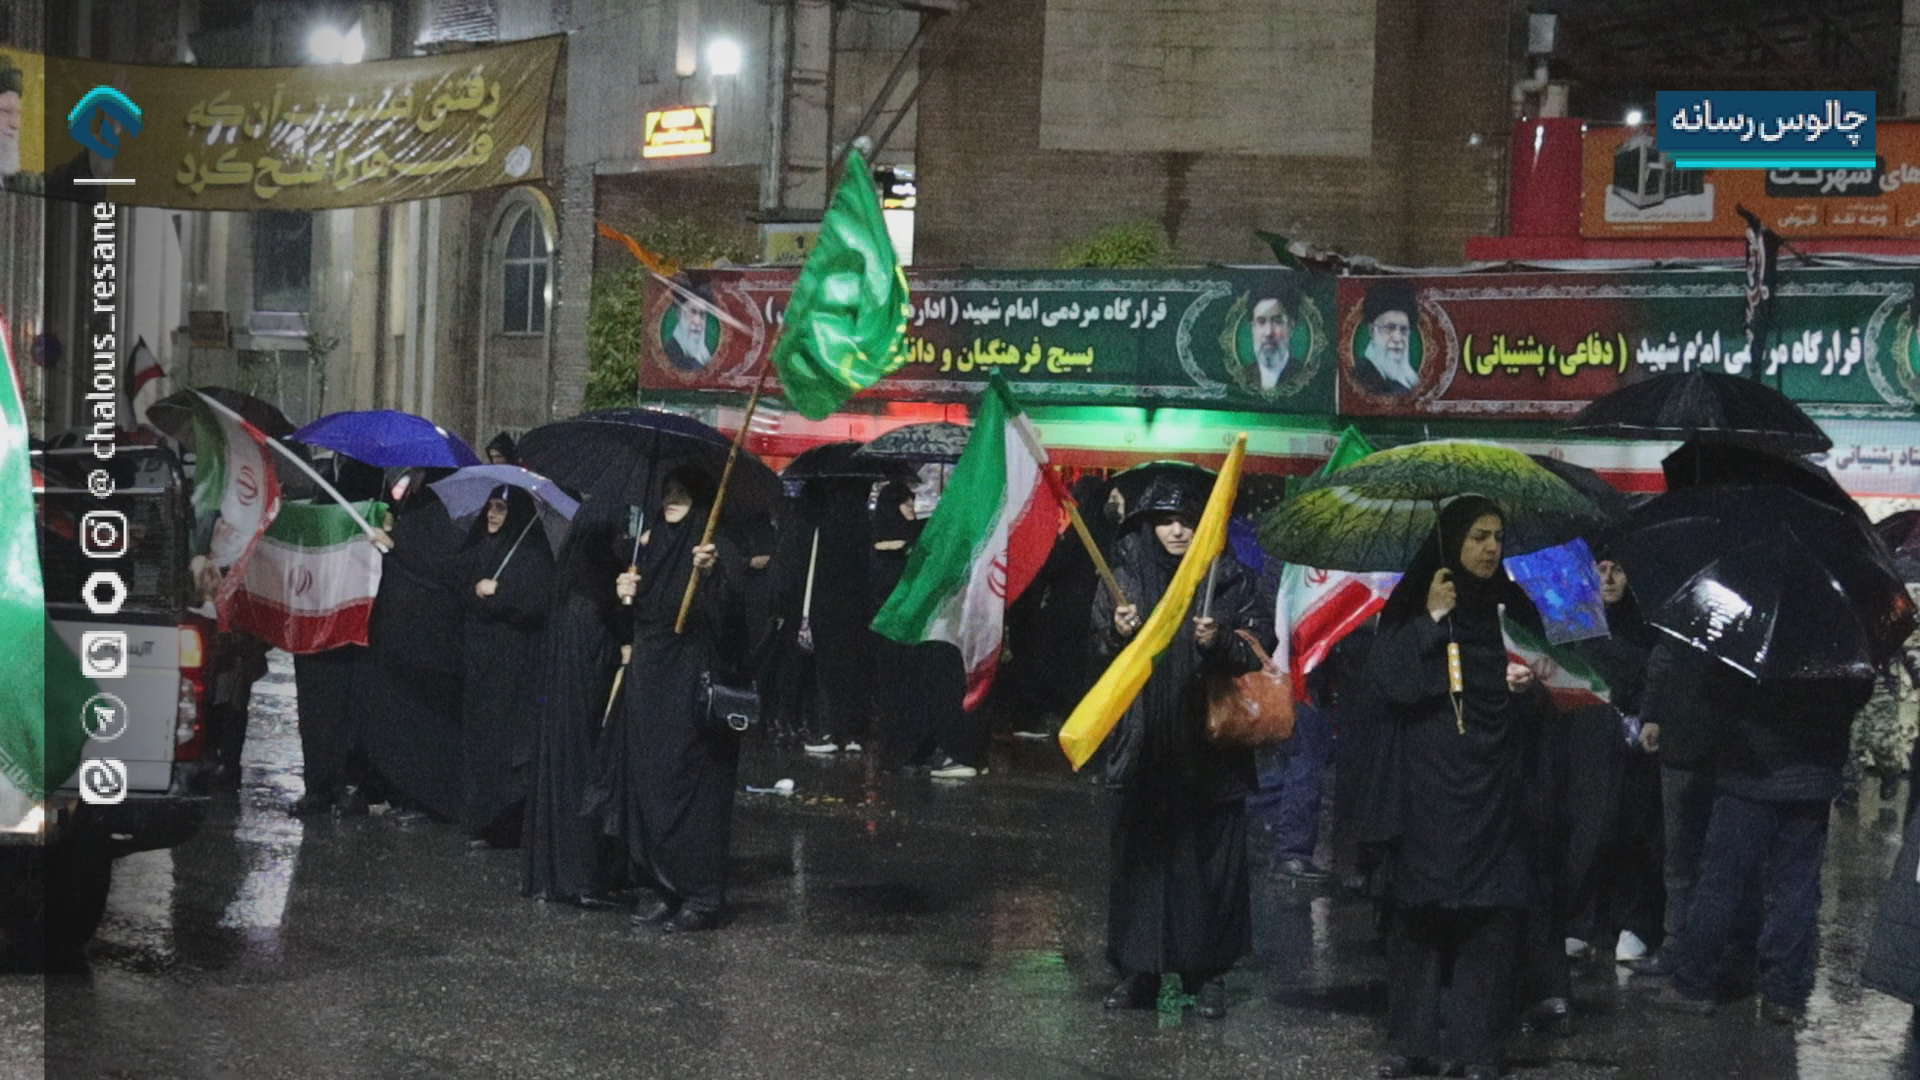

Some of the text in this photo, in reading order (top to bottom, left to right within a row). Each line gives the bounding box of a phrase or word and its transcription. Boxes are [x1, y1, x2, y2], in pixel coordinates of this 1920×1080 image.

[176, 148, 254, 194] کرد
[962, 297, 1002, 325] شهید
[1004, 297, 1038, 327] امام
[1041, 300, 1100, 328] مردمی
[1103, 296, 1167, 329] قرارگاه
[940, 348, 952, 373] و
[957, 336, 1042, 374] فرهنگیان
[1046, 346, 1094, 374] بسیج
[1636, 331, 1681, 372] شهید
[1683, 329, 1721, 373] امام
[1791, 327, 1862, 376] قرارگاه
[1836, 444, 1894, 473] پشتیبانی
